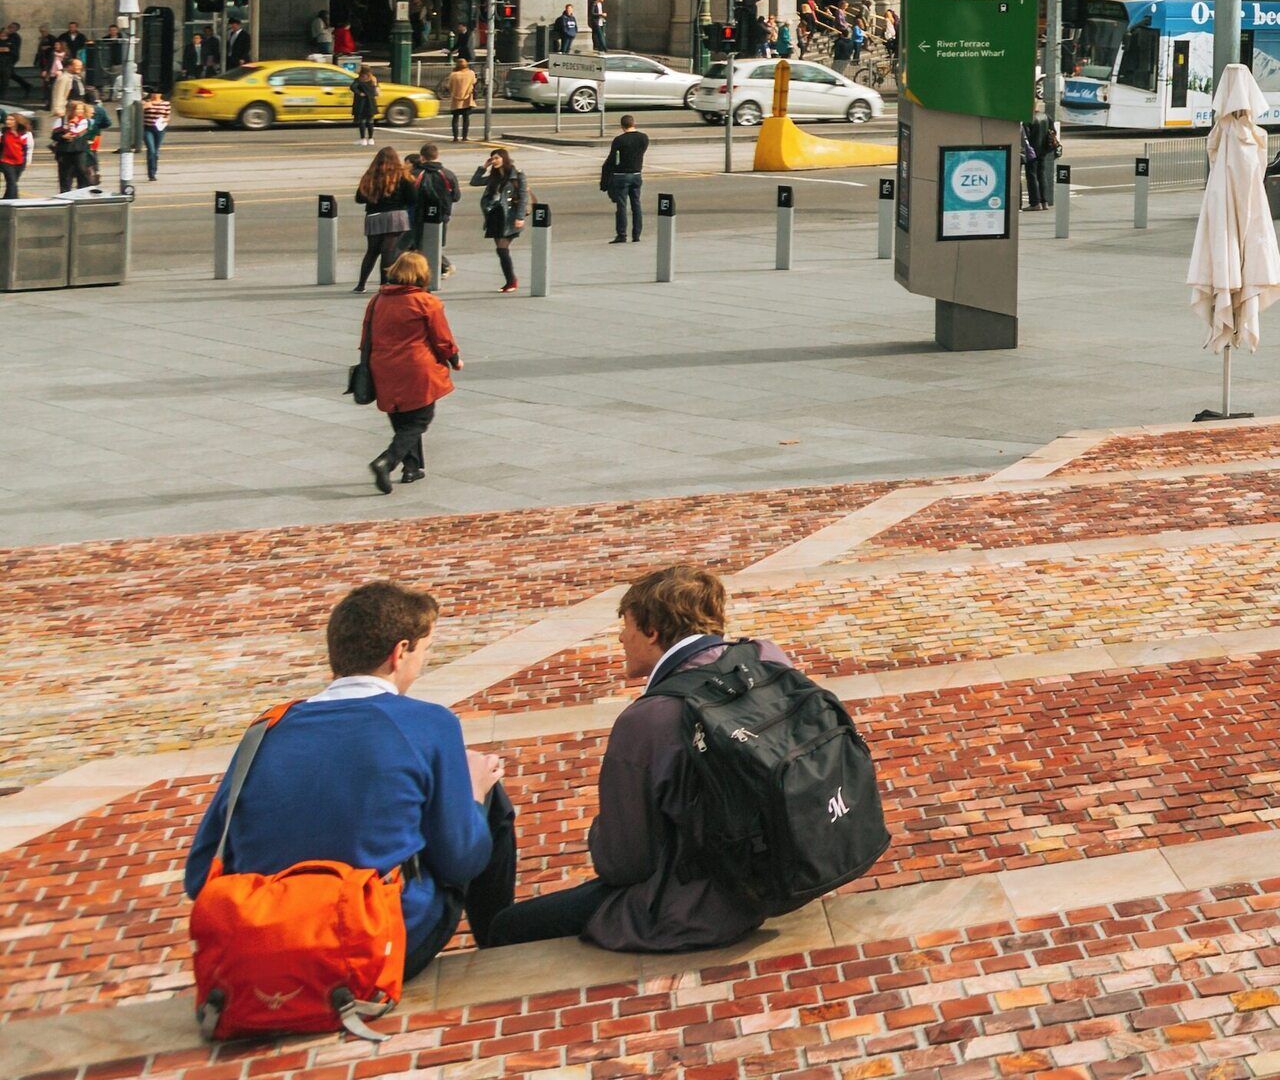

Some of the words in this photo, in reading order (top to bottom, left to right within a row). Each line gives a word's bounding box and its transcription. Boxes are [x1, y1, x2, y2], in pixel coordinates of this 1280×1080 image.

[936, 40, 958, 48] River
[959, 40, 990, 48] Terrace
[936, 50, 980, 58] Federation
[960, 175, 989, 187] ZEN
[828, 786, 850, 823] M
